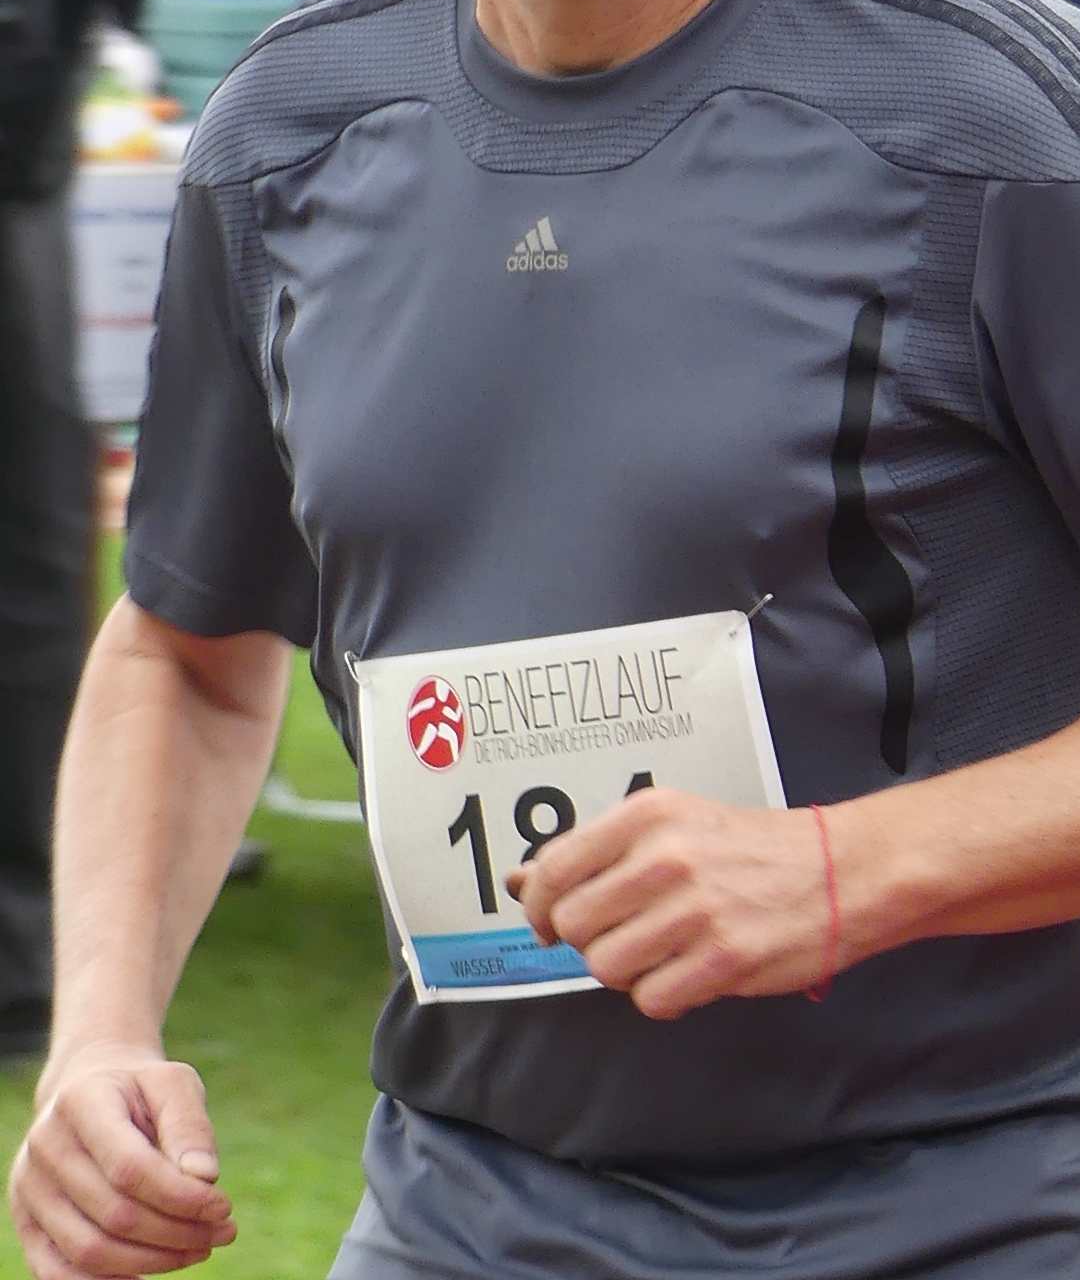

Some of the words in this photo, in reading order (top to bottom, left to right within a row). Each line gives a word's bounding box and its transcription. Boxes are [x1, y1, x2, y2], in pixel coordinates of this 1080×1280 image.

[506, 248, 569, 271] adidas
[465, 648, 683, 737] BENEFIZLAUF
[615, 712, 695, 747] GYMNASIUM
[447, 770, 657, 914] 18
[450, 959, 507, 978] WASSER
